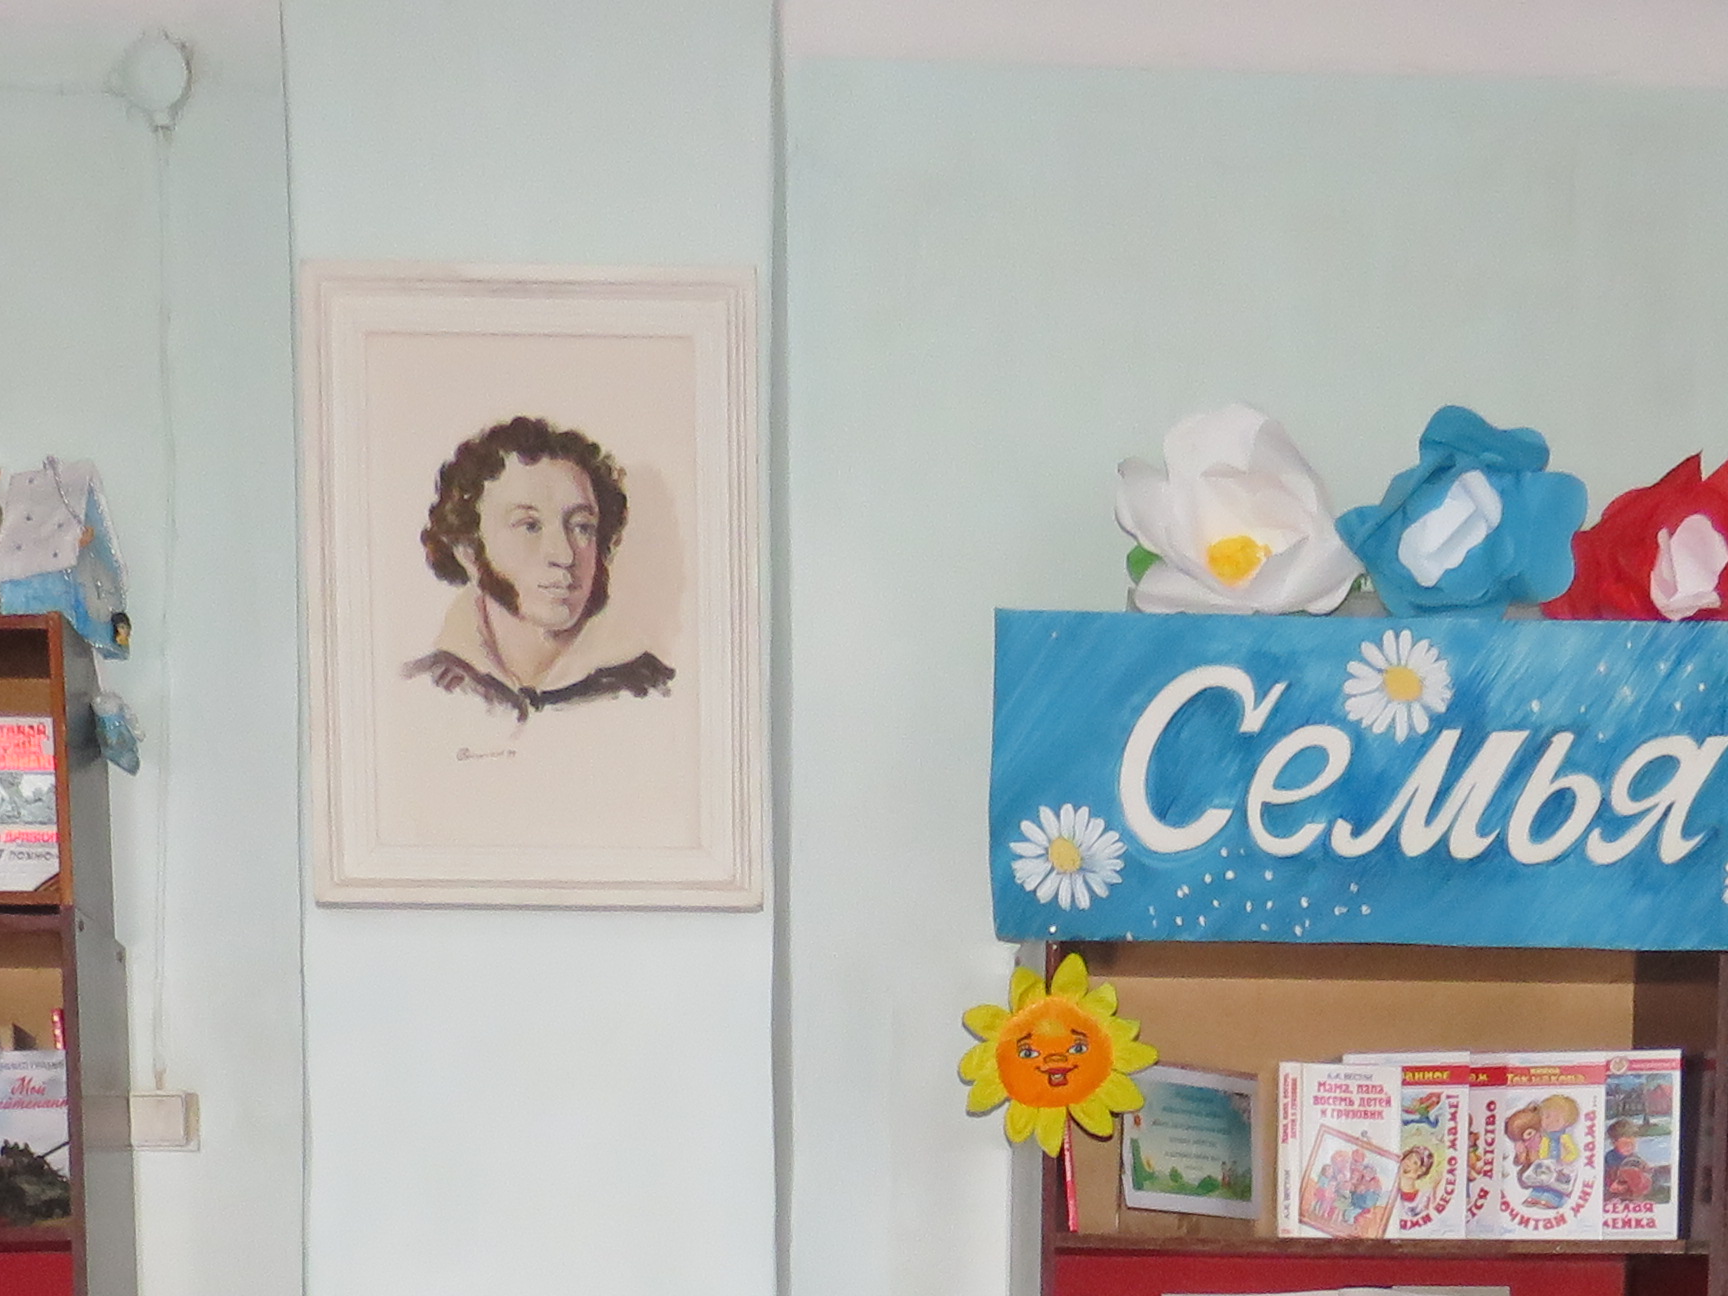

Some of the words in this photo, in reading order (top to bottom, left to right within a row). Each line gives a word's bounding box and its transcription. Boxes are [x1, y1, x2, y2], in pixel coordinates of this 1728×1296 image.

[10, 1076, 46, 1097] Мой
[1312, 1095, 1355, 1107] восемь
[1358, 1097, 1392, 1108] детей
[1331, 1109, 1385, 1121] грузовик
[1482, 1099, 1498, 1180] ДЕТСТВО
[1499, 1189, 1568, 1232] ОЧИТАЙ
[1603, 1201, 1656, 1214] СЕЛАЯ
